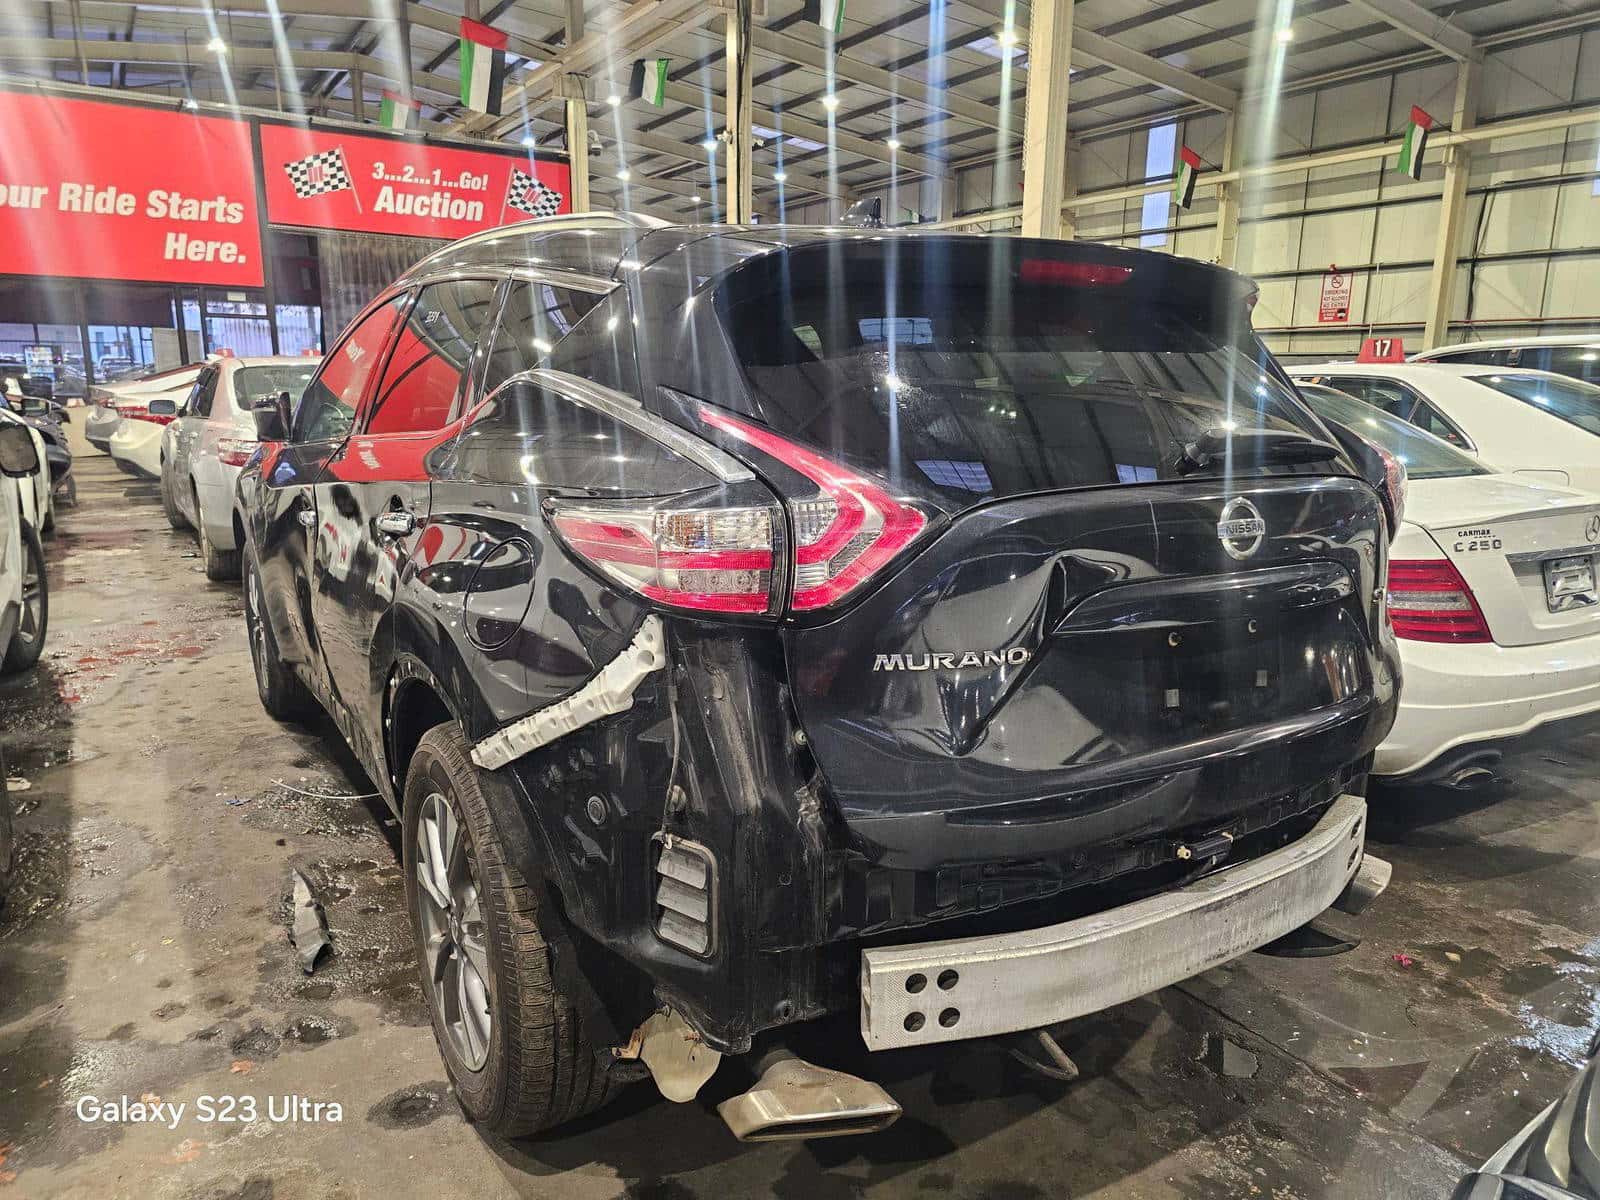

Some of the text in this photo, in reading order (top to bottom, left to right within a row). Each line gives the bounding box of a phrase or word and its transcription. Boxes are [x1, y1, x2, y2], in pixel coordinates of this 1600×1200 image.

[58, 182, 136, 216] Ride
[146, 190, 244, 224] Starts
[373, 185, 485, 221] Auction
[164, 232, 247, 264] Here.
[1376, 340, 1391, 357] 17
[1453, 540, 1502, 552] C 250
[872, 647, 1029, 672] MURANO
